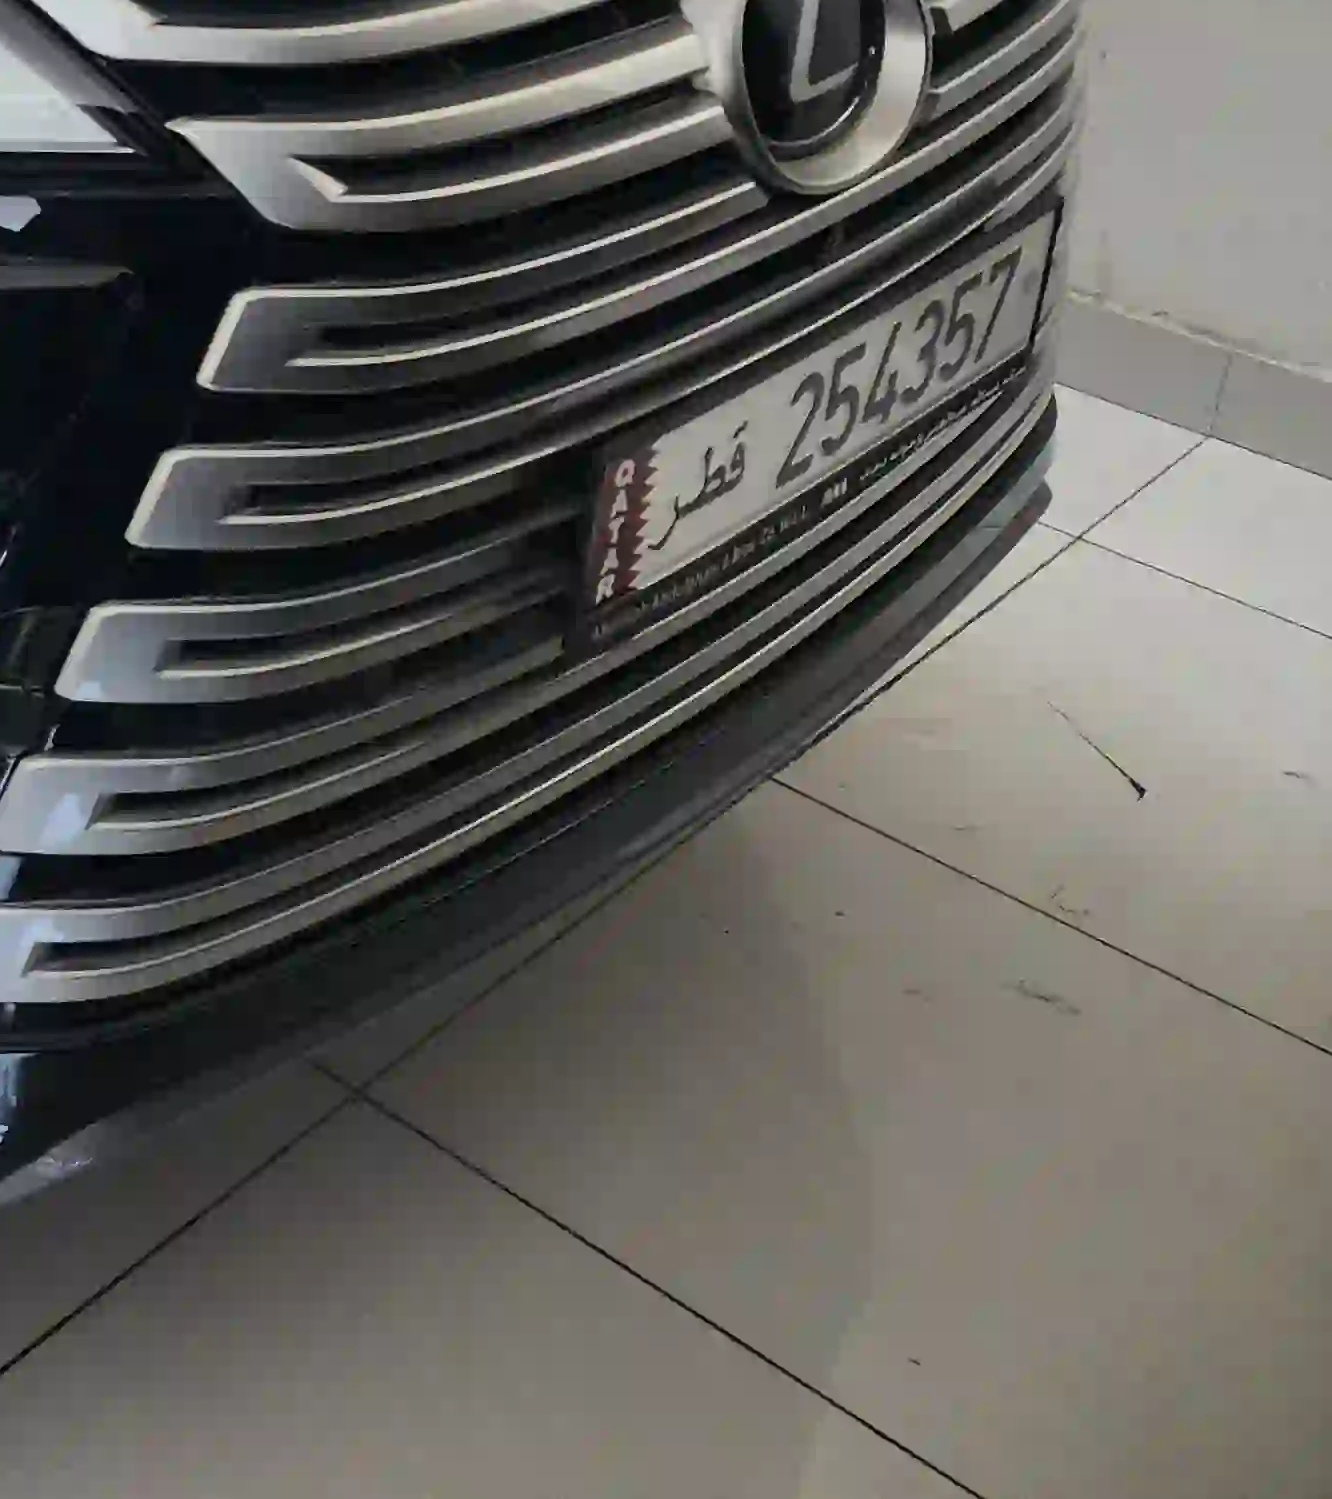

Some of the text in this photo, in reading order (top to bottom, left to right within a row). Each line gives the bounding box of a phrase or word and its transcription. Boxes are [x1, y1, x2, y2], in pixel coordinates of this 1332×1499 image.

[775, 245, 1022, 489] 254357
[595, 457, 636, 604] QATAR
[648, 420, 749, 551] قطر
